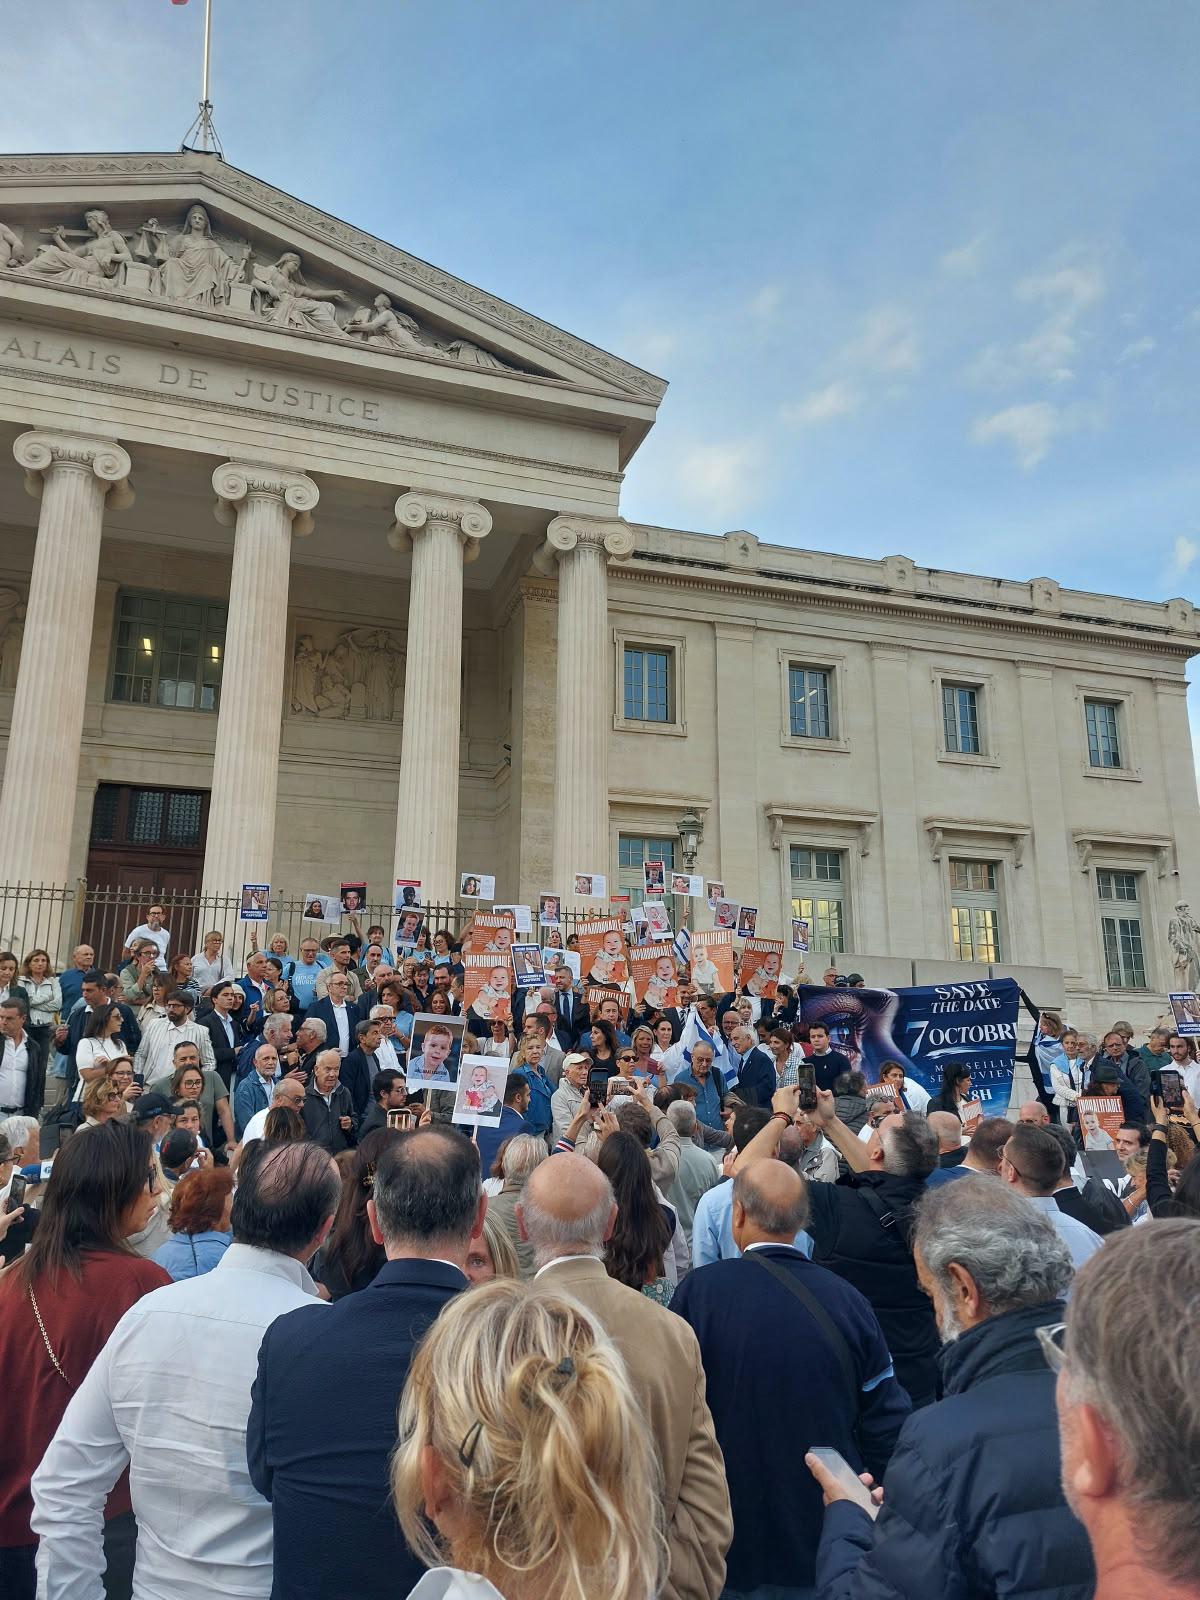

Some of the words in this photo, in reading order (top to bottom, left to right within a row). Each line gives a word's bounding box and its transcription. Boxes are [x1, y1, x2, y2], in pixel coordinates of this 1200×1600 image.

[159, 363, 208, 391] DE
[235, 379, 380, 421] JUSTICE
[935, 983, 993, 1000] SAVE
[930, 1000, 960, 1014] THE
[963, 997, 1001, 1012] DATE
[905, 1020, 930, 1058] 7
[928, 1022, 1017, 1046] OCTOBR
[930, 1074, 944, 1083] SE
[966, 1088, 993, 1101] 8H
